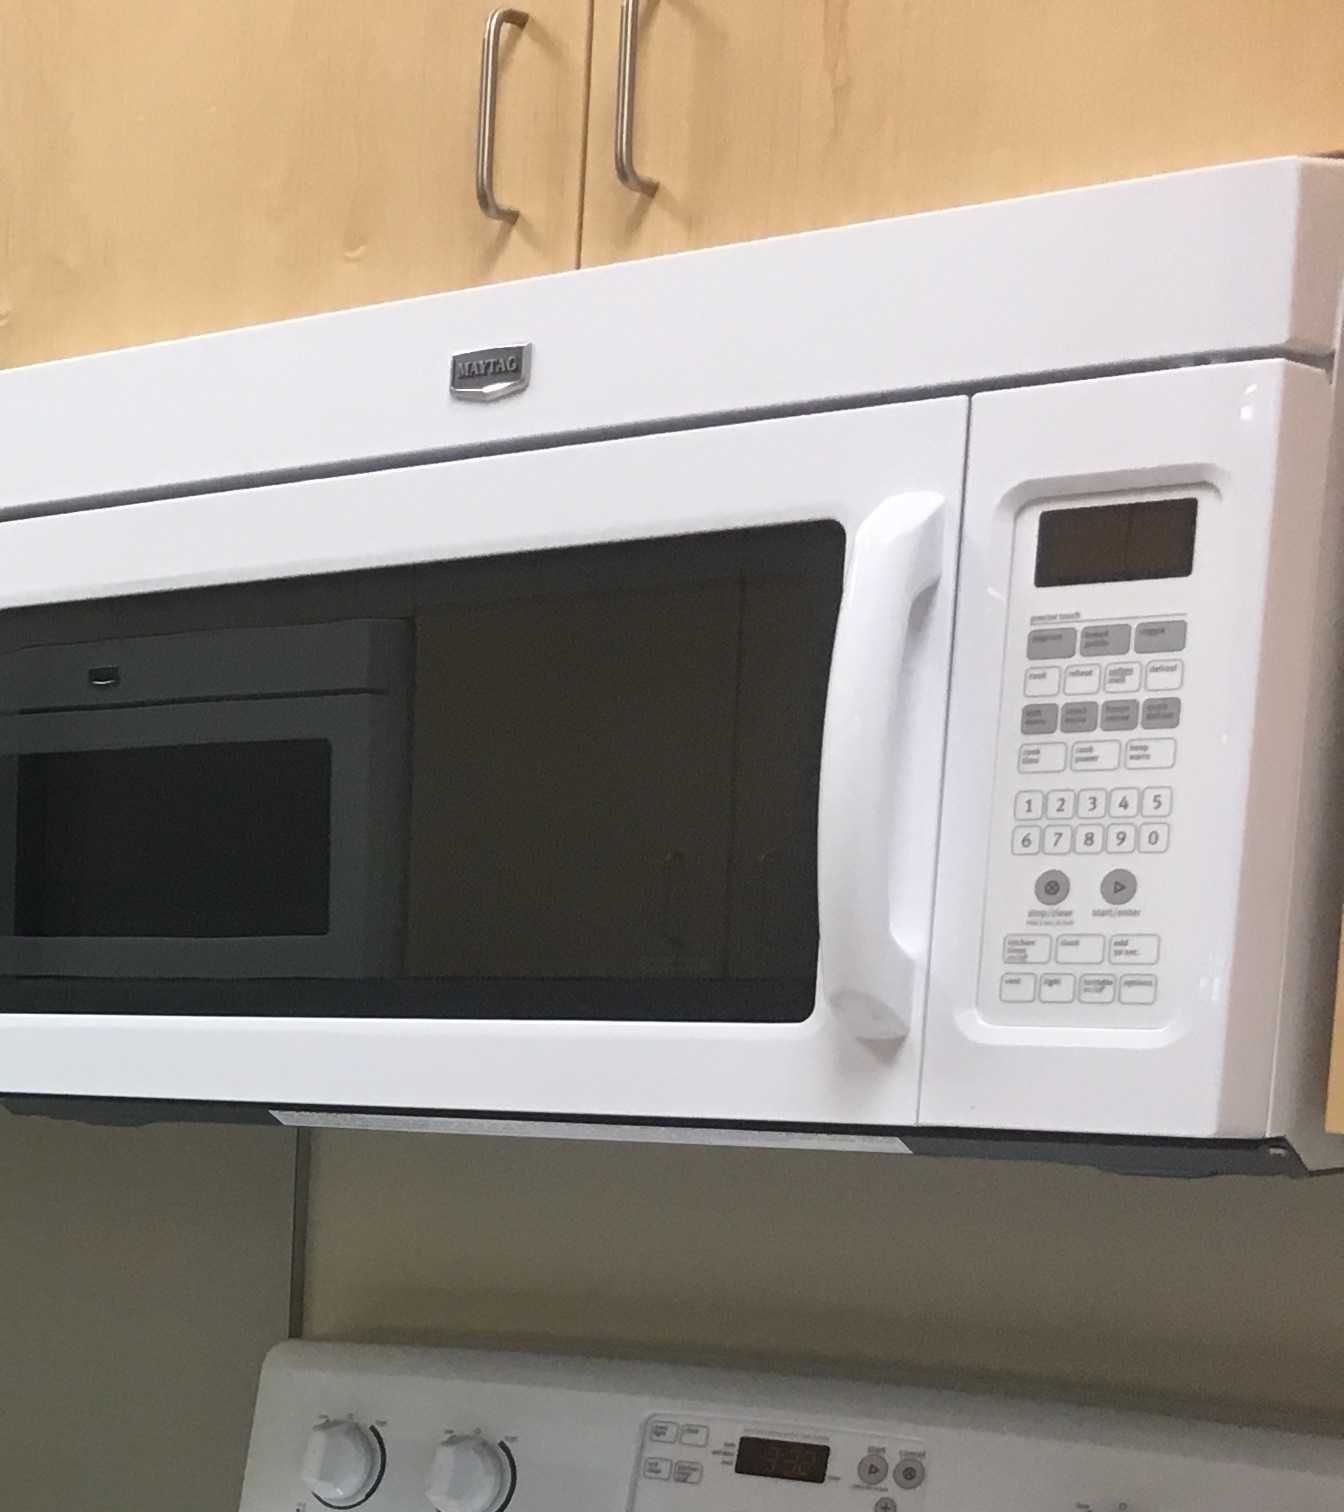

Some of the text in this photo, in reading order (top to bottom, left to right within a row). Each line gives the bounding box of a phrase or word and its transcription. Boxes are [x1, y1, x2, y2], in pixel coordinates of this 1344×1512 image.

[456, 355, 518, 379] MAYTAG
[1024, 799, 1033, 813] 1
[1055, 797, 1066, 812] 2
[1087, 796, 1098, 812] 3
[1118, 796, 1129, 811] 4
[1152, 795, 1162, 810] 5
[1021, 832, 1032, 848] 6
[1053, 832, 1063, 847] 7
[1084, 831, 1095, 846] 8
[1115, 830, 1127, 845] 9
[1148, 830, 1159, 845] 0
